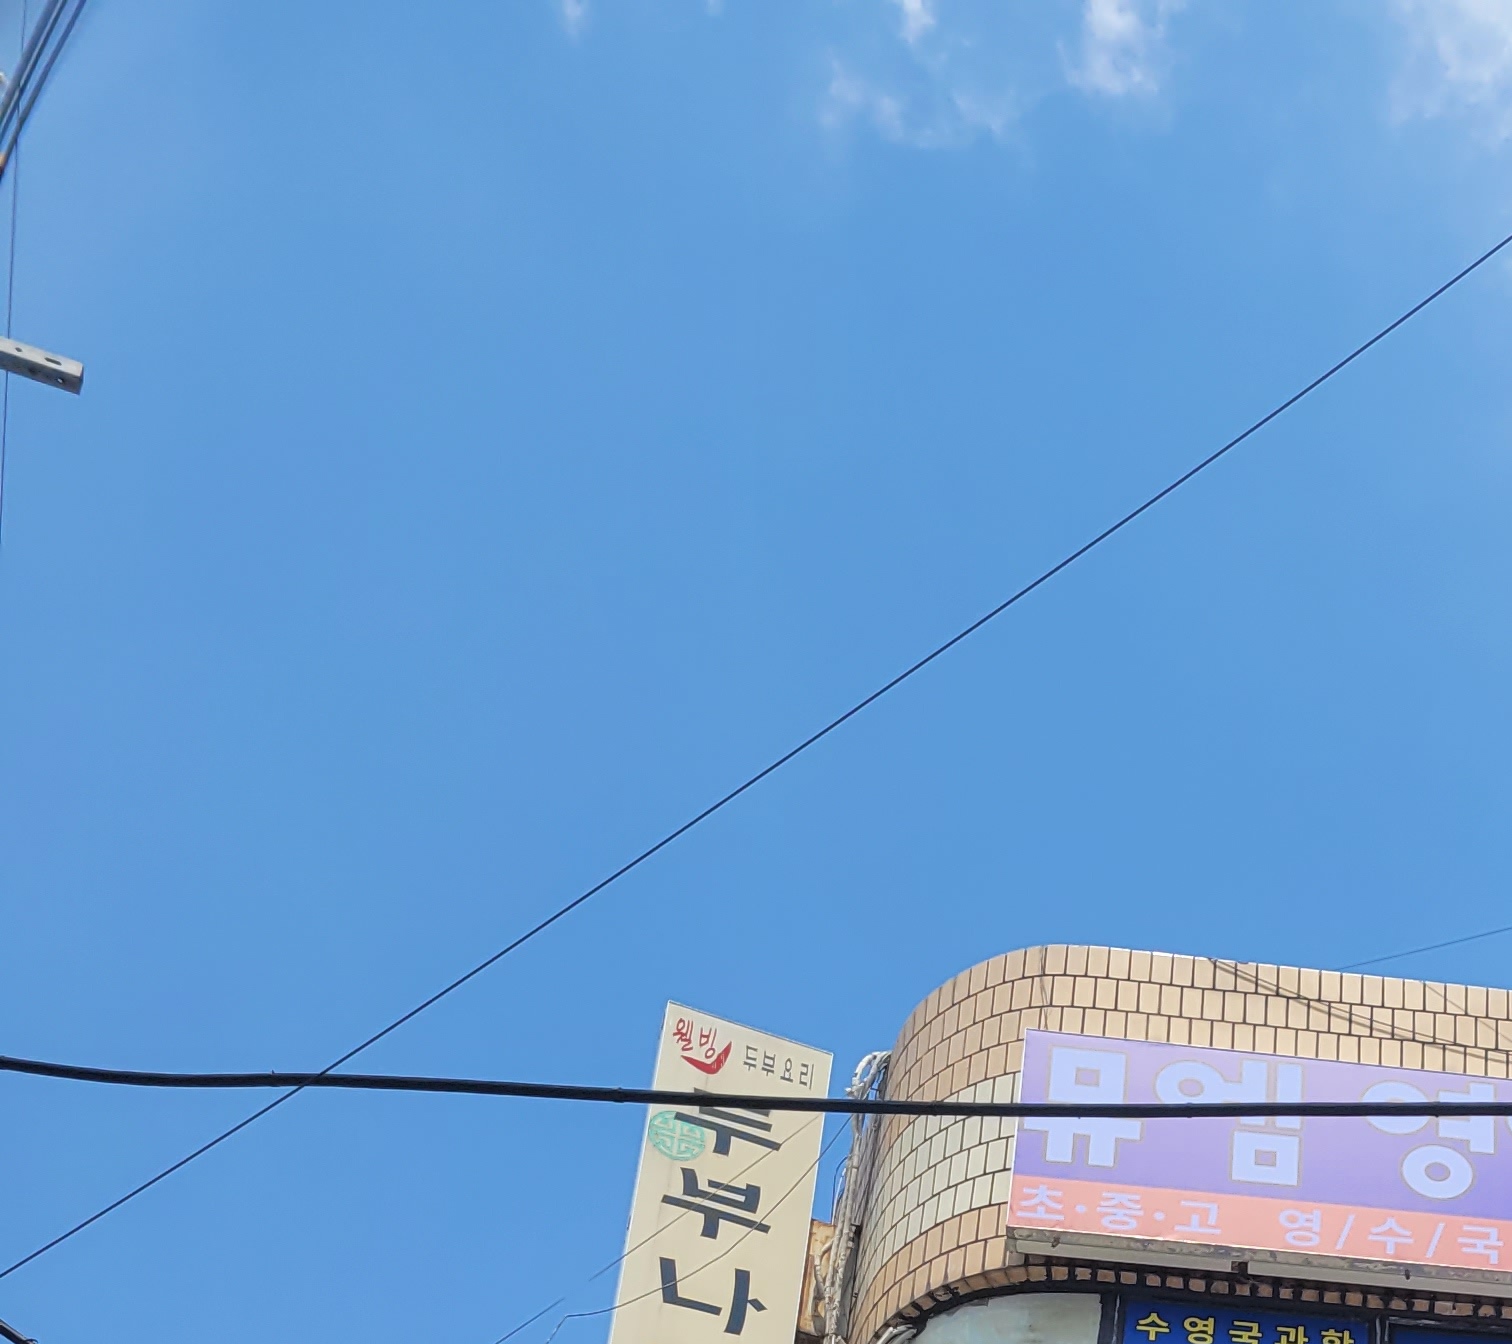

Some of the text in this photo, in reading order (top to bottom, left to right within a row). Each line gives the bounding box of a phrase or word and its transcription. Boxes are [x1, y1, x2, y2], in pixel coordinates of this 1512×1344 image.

[673, 1018, 814, 1090] 웰빙 두부요리
[1021, 1045, 1304, 1187] 뮤엠
